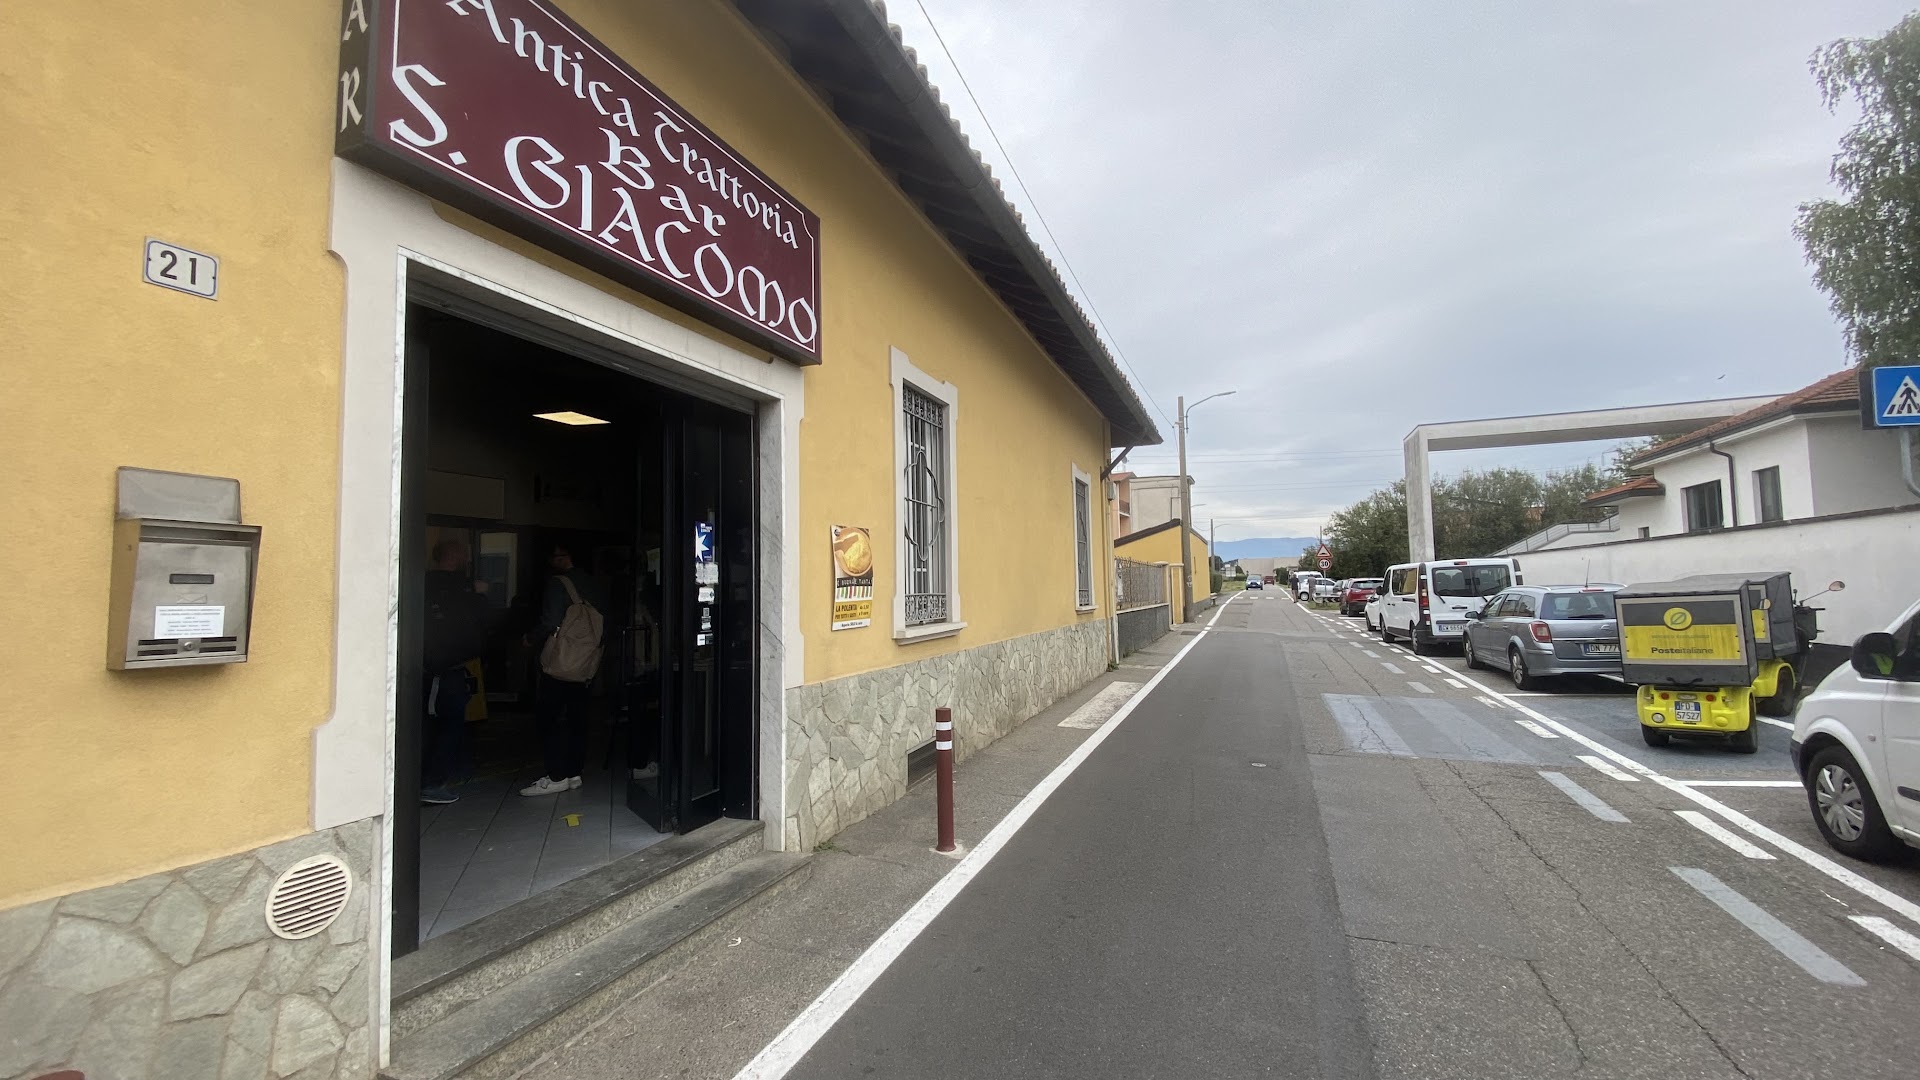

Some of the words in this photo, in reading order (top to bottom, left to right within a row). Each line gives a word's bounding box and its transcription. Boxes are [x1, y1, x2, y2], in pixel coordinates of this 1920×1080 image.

[446, 0, 641, 137] Antica
[653, 111, 799, 249] Trattoria
[388, 64, 467, 165] S.
[504, 135, 818, 344] GIACOMO
[599, 127, 726, 237] Bar
[160, 250, 198, 286] 21
[1676, 711, 1700, 720] 57527
